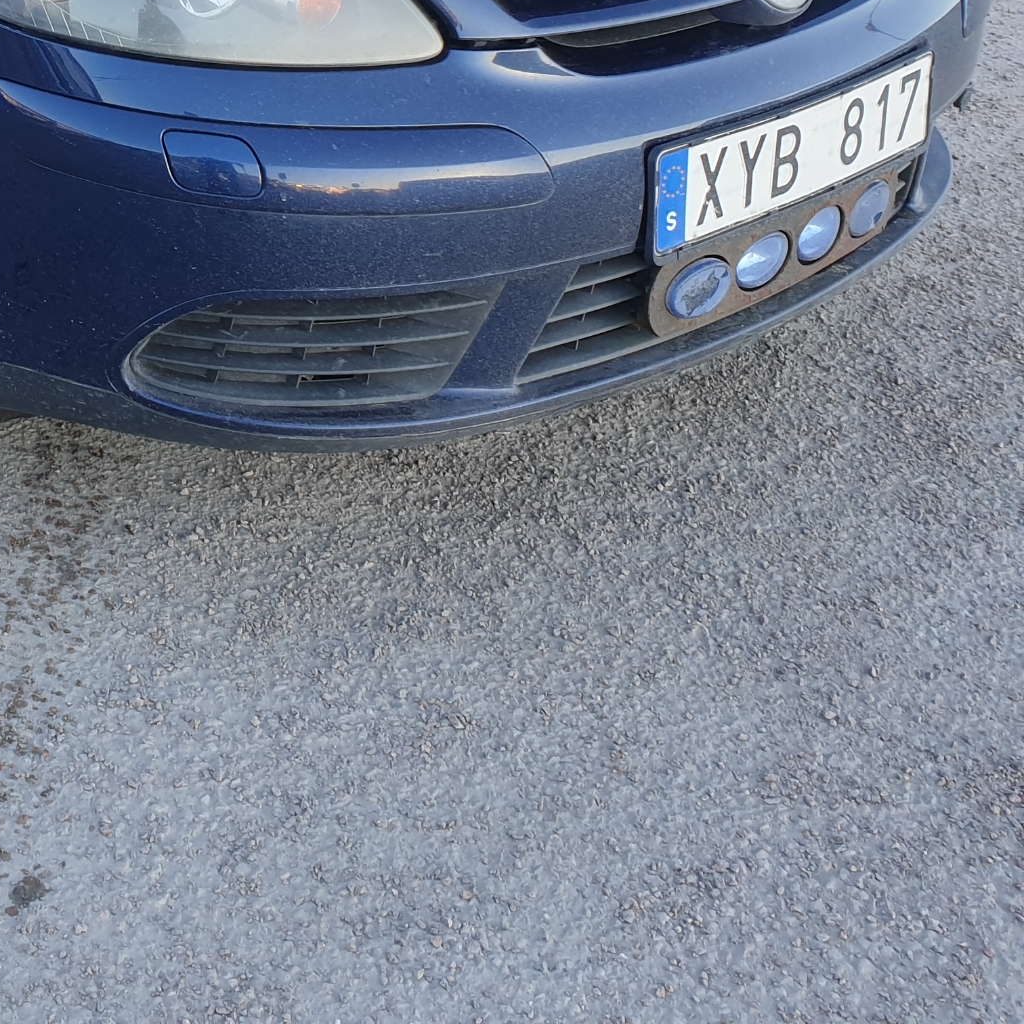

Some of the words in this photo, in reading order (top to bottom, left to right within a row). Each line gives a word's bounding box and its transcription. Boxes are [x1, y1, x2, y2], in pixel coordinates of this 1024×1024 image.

[696, 125, 801, 227] XYB
[840, 69, 922, 166] 817
[666, 210, 677, 232] S
